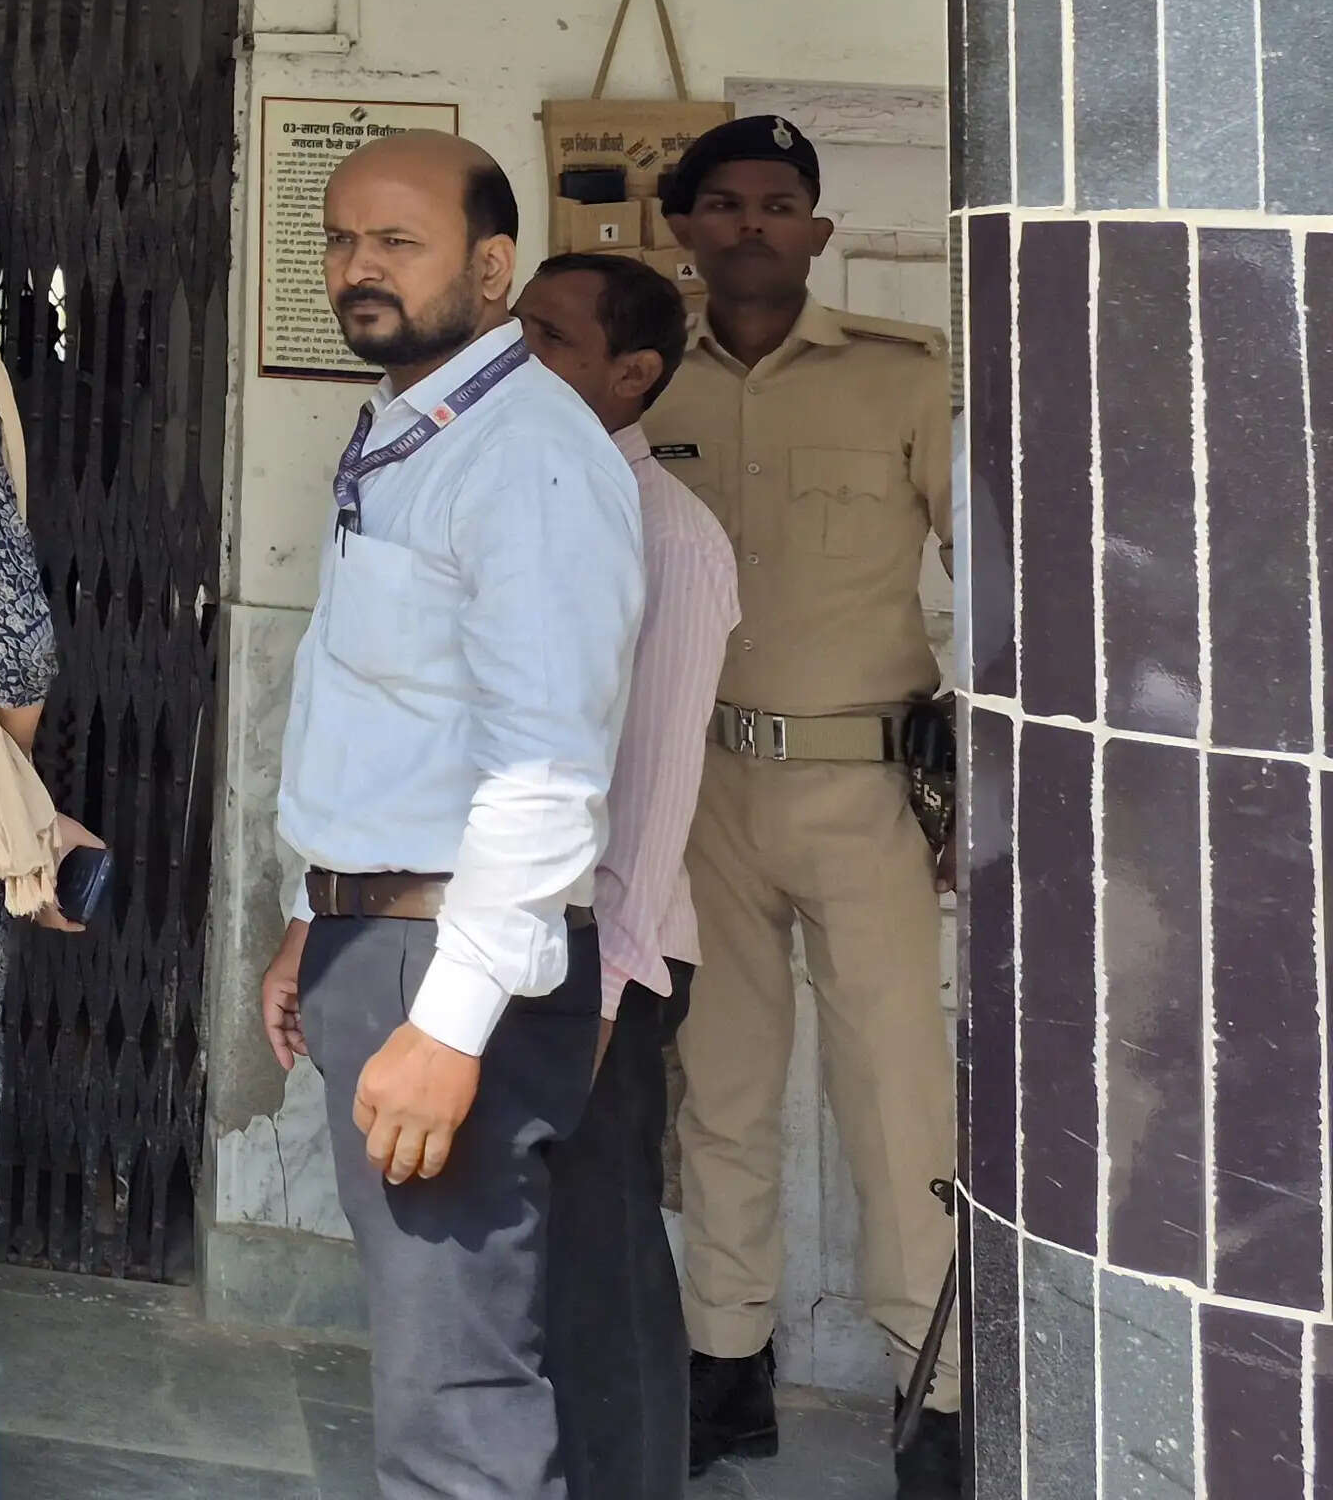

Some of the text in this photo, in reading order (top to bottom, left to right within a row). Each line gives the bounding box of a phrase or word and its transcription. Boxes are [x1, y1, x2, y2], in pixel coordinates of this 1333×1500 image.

[283, 123, 330, 135] 03-सारण
[333, 122, 363, 136] शिक्षक
[291, 138, 323, 149] मतदान
[326, 138, 344, 150] कैसे
[604, 226, 613, 239] 1
[681, 265, 693, 277] 4
[392, 426, 427, 455] CHAPRA
